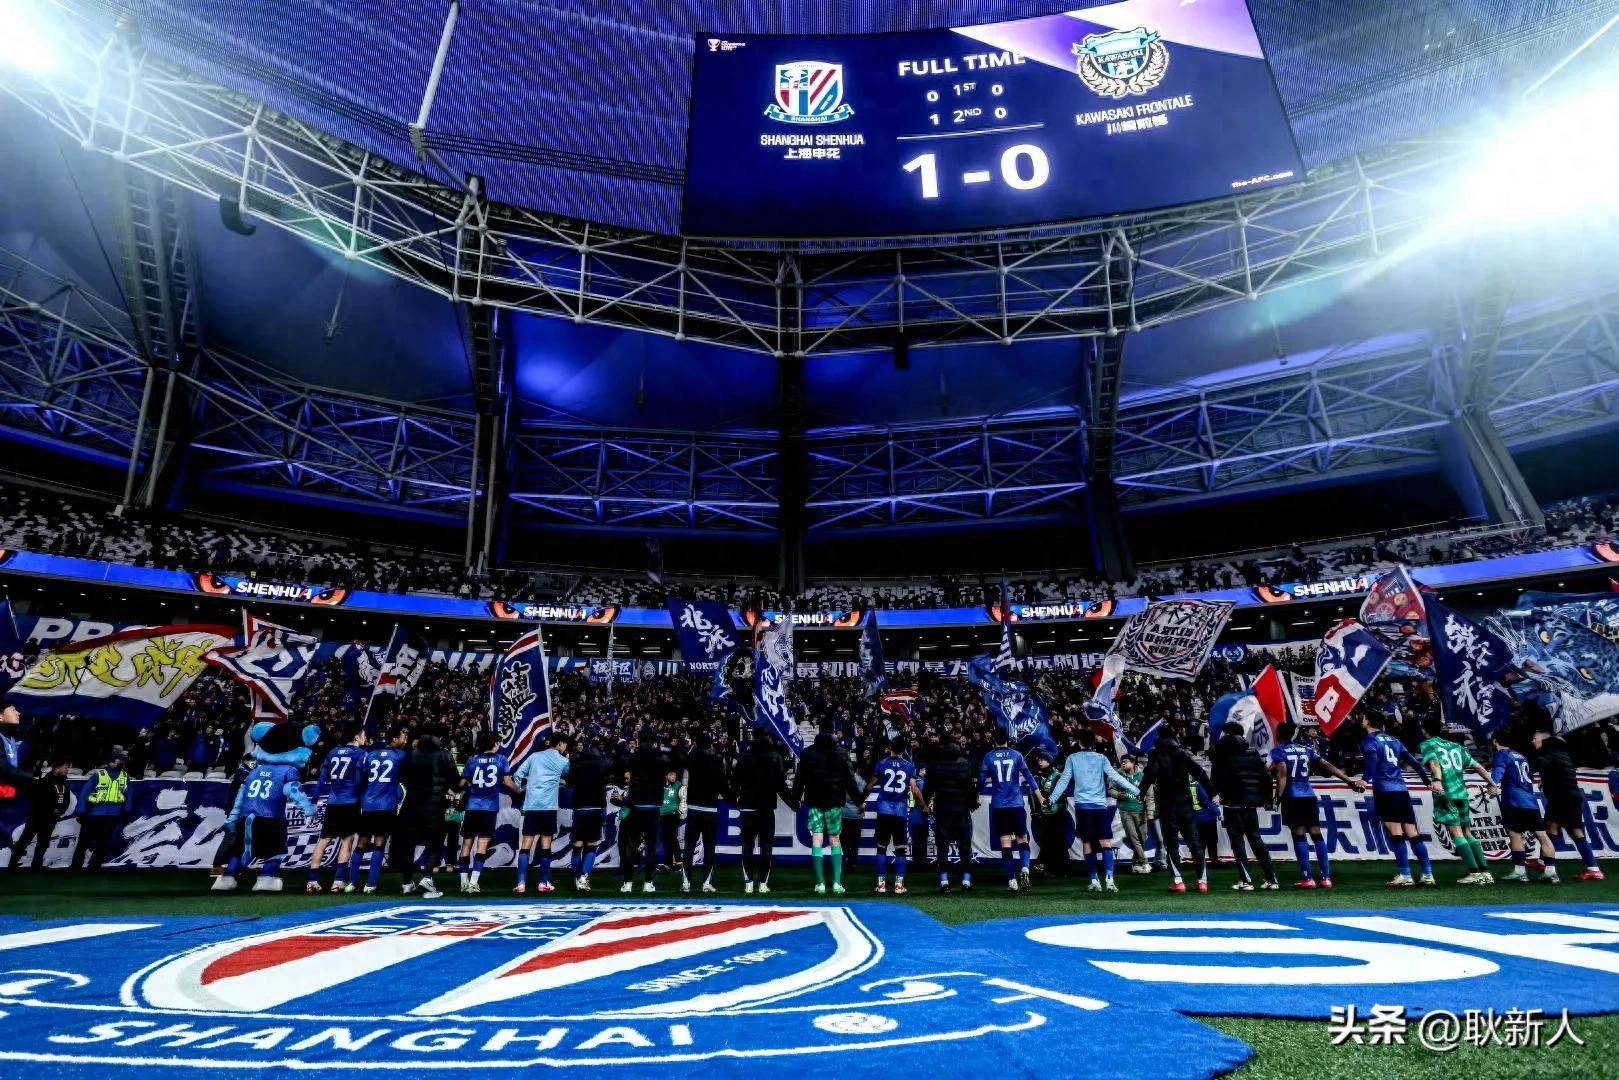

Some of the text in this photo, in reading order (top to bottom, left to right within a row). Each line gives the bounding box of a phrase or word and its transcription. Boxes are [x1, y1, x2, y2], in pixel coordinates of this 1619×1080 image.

[898, 51, 1026, 76] FULL TIME
[926, 82, 1003, 102] 0 1ST 0
[929, 107, 1007, 126] 1 2ND 0
[1075, 94, 1195, 125] KAWASAKI FRONTALE
[760, 134, 865, 146] SHANGHAI SHENHUA
[783, 148, 841, 159] 上海申花
[235, 581, 313, 600] SHENHUA
[1293, 577, 1369, 599] SHENHUA
[523, 605, 587, 620] SHENHUA
[1021, 604, 1084, 618] SHENHUA
[1286, 754, 1309, 777] 73
[1385, 744, 1398, 767] 4
[1437, 748, 1463, 770] 30
[330, 757, 351, 779] 27
[368, 760, 393, 782] 32
[472, 765, 498, 788] 43
[993, 760, 1014, 783] 17
[248, 779, 272, 798] 93
[883, 769, 907, 794] 23
[47, 1020, 694, 1051] SHANGHAI
